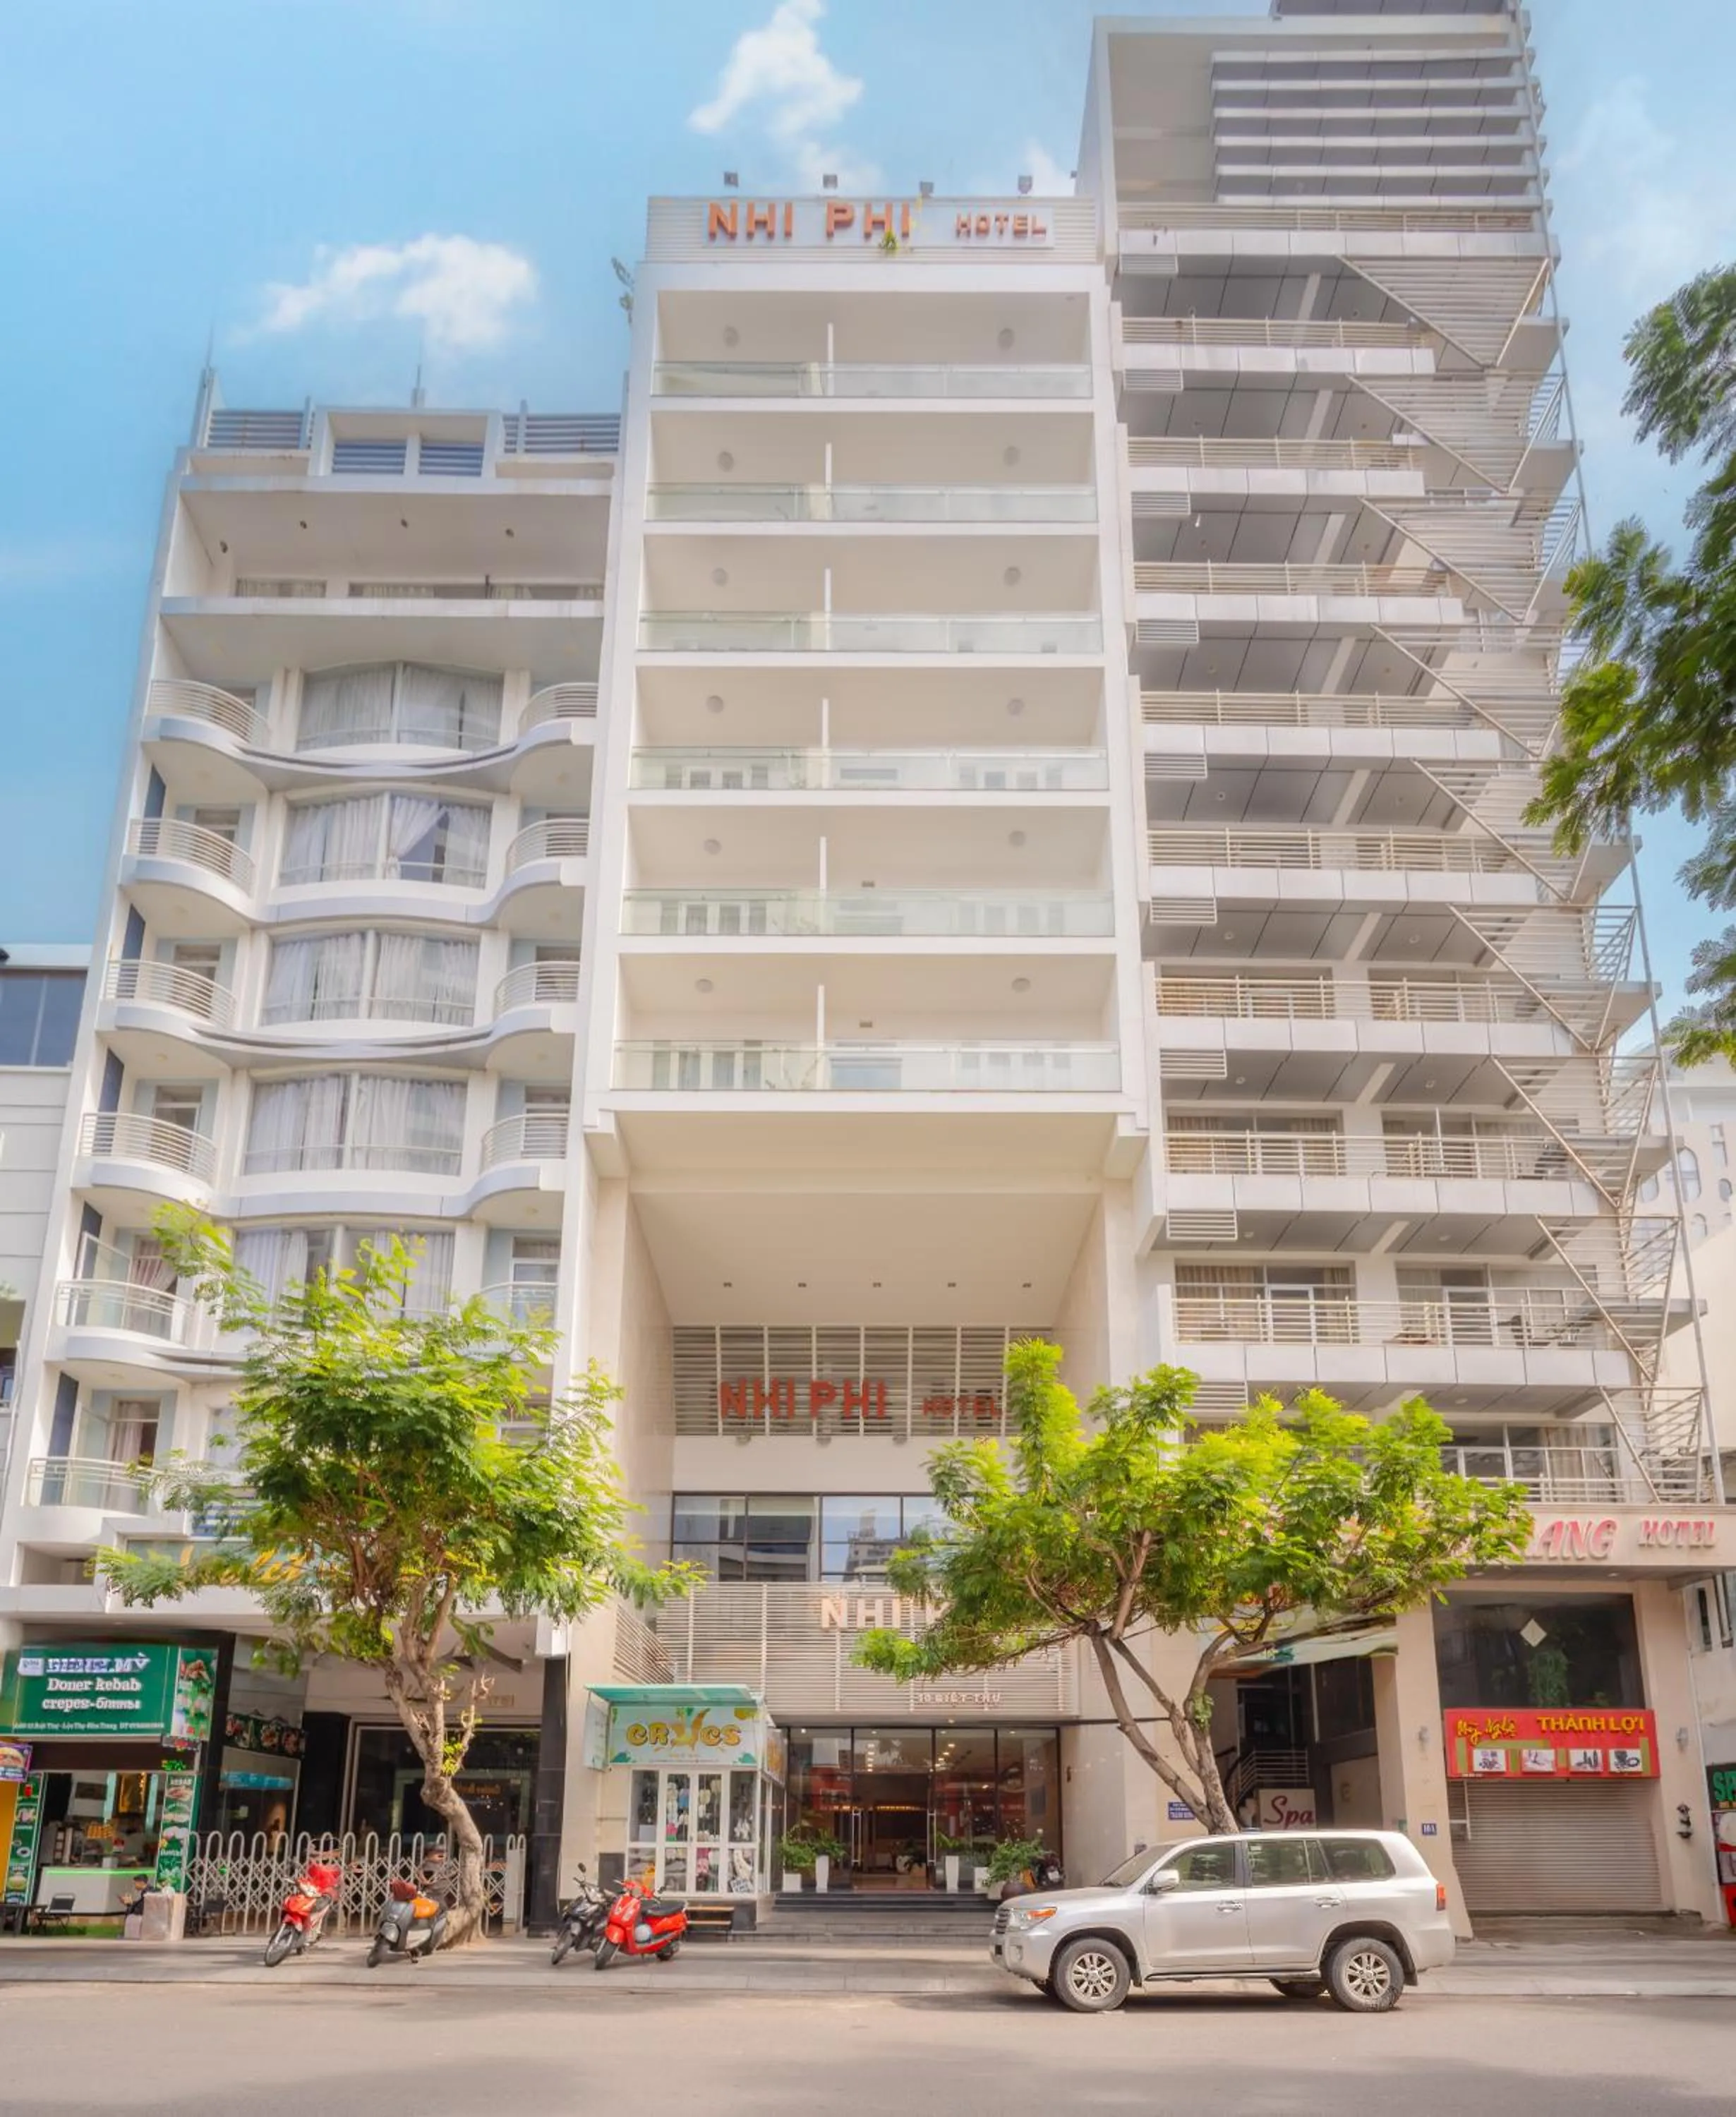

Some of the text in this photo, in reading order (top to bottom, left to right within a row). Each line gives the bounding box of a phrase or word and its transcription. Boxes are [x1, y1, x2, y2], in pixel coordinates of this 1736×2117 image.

[708, 201, 1047, 239] NHI PHI HOTEL
[720, 1377, 795, 1419] NHI
[809, 1379, 887, 1418] PHI
[1638, 1519, 1715, 1548] HOTEL
[47, 1677, 141, 1691] Doner kebab
[1538, 1713, 1605, 1733] THÀNH
[1263, 1795, 1315, 1829] Spa
